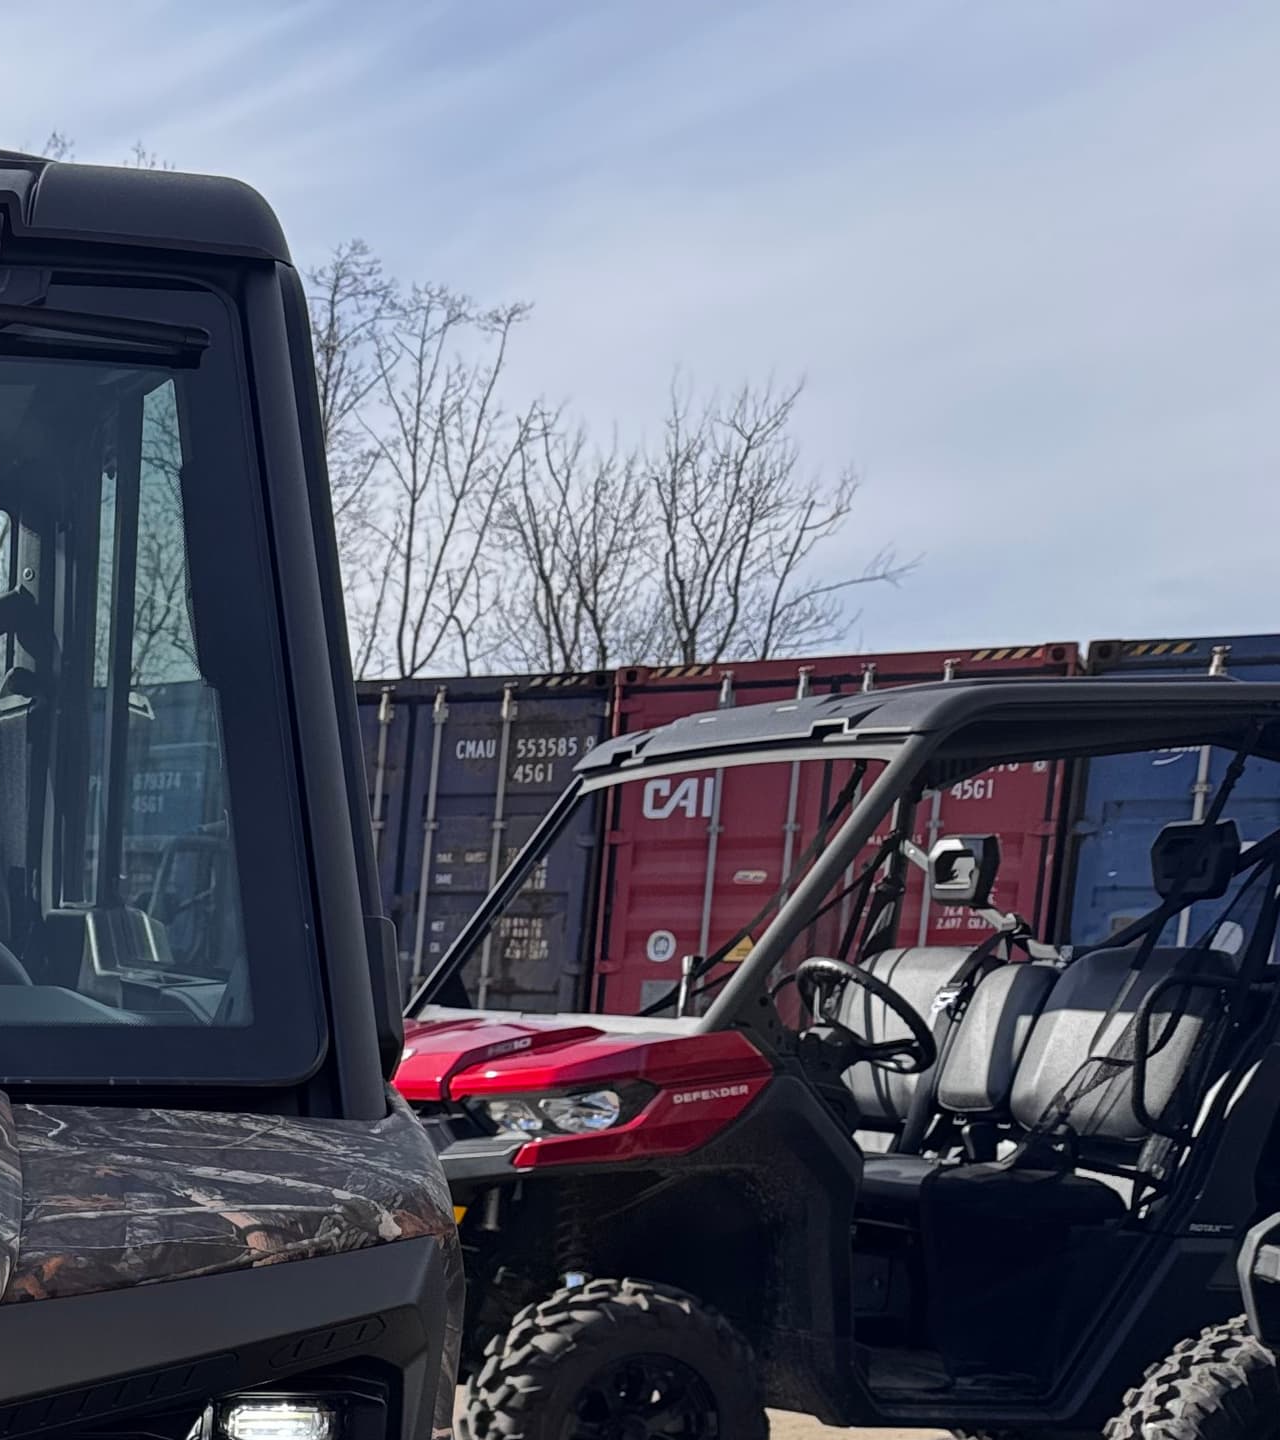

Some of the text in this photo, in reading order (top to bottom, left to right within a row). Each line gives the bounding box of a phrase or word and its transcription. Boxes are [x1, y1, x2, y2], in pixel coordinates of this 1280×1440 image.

[456, 740, 496, 759] CMAU
[516, 738, 578, 758] 553585
[513, 763, 553, 783] 45G1
[643, 777, 714, 819] CAI
[950, 779, 994, 799] 45G1
[673, 1084, 748, 1105] DEFENDER
